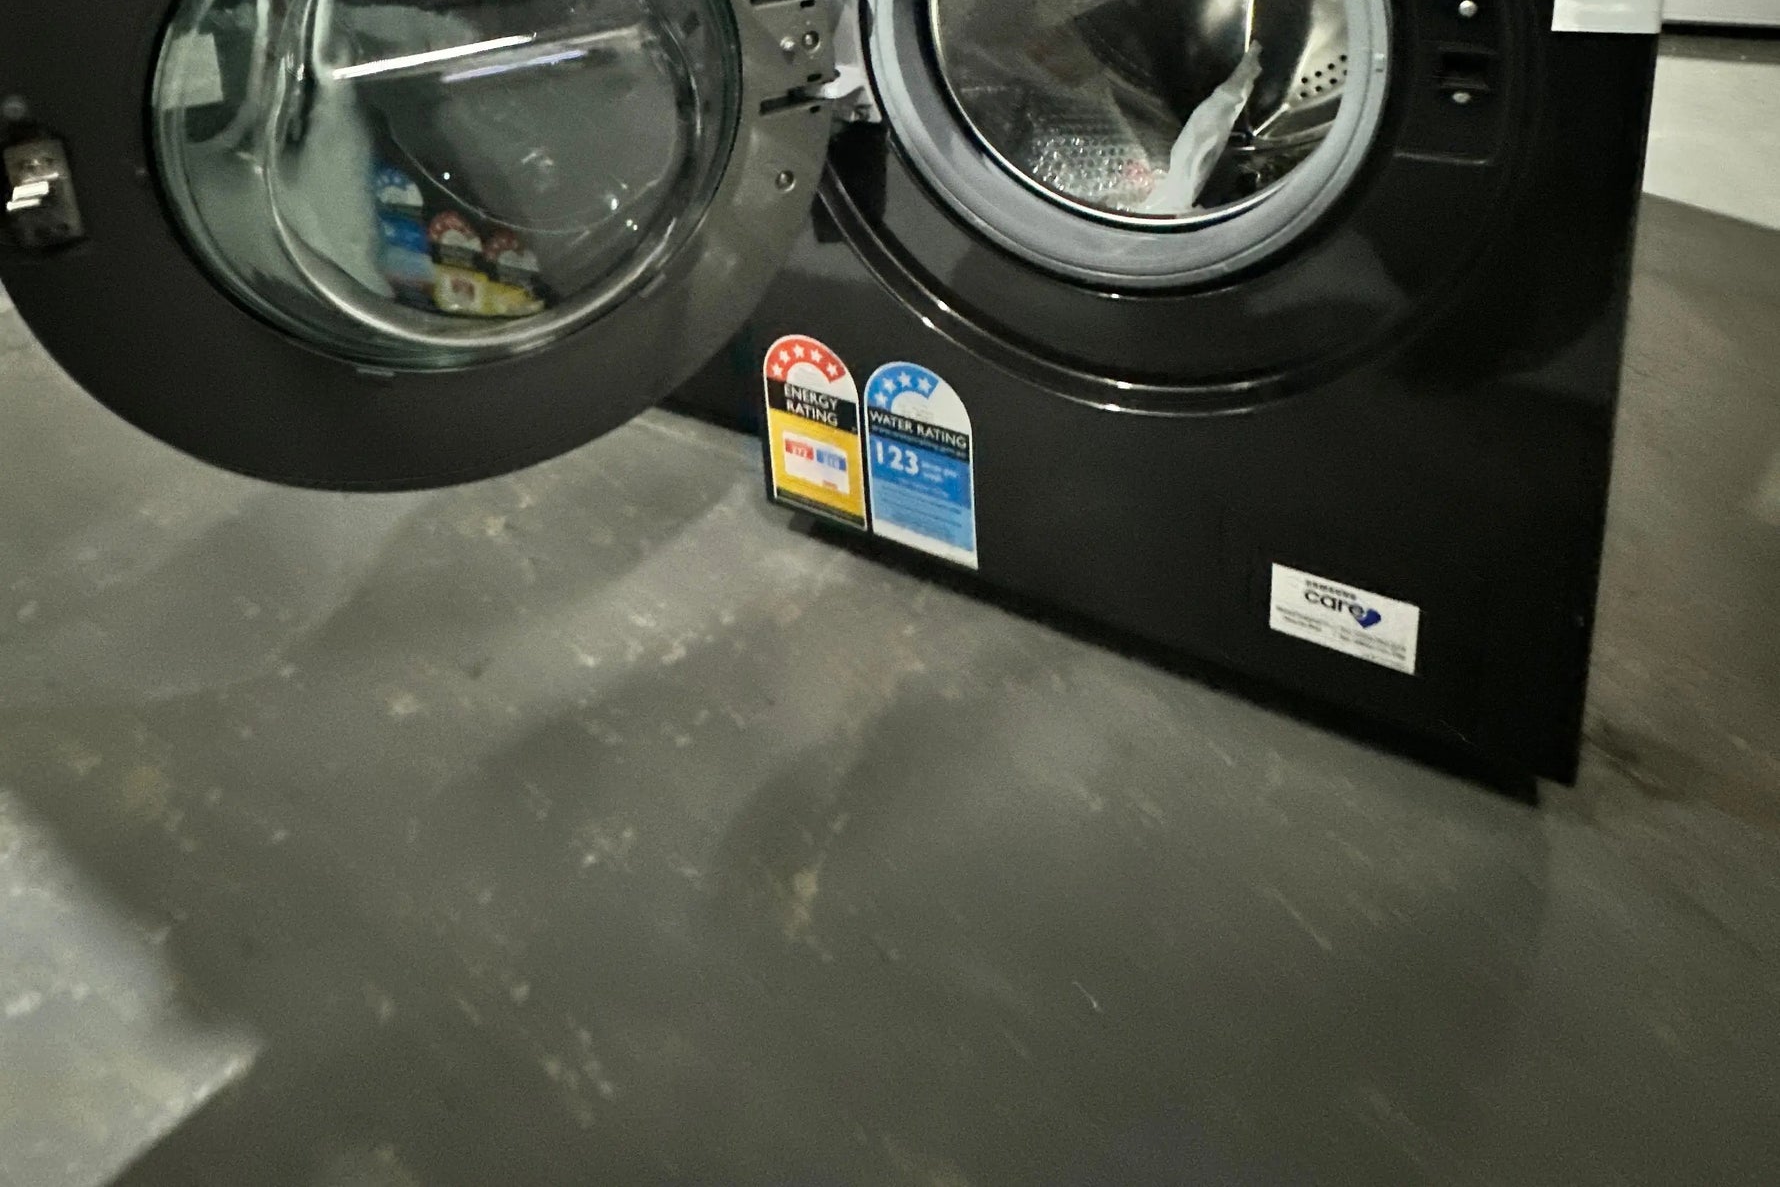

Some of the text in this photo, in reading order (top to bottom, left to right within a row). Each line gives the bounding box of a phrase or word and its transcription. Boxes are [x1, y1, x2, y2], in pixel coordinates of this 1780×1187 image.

[784, 382, 838, 411] ENERGY
[786, 398, 838, 427] RATING
[869, 409, 913, 434] WATER
[916, 424, 967, 449] RATING
[875, 440, 920, 476] 123
[1304, 590, 1365, 621] care
